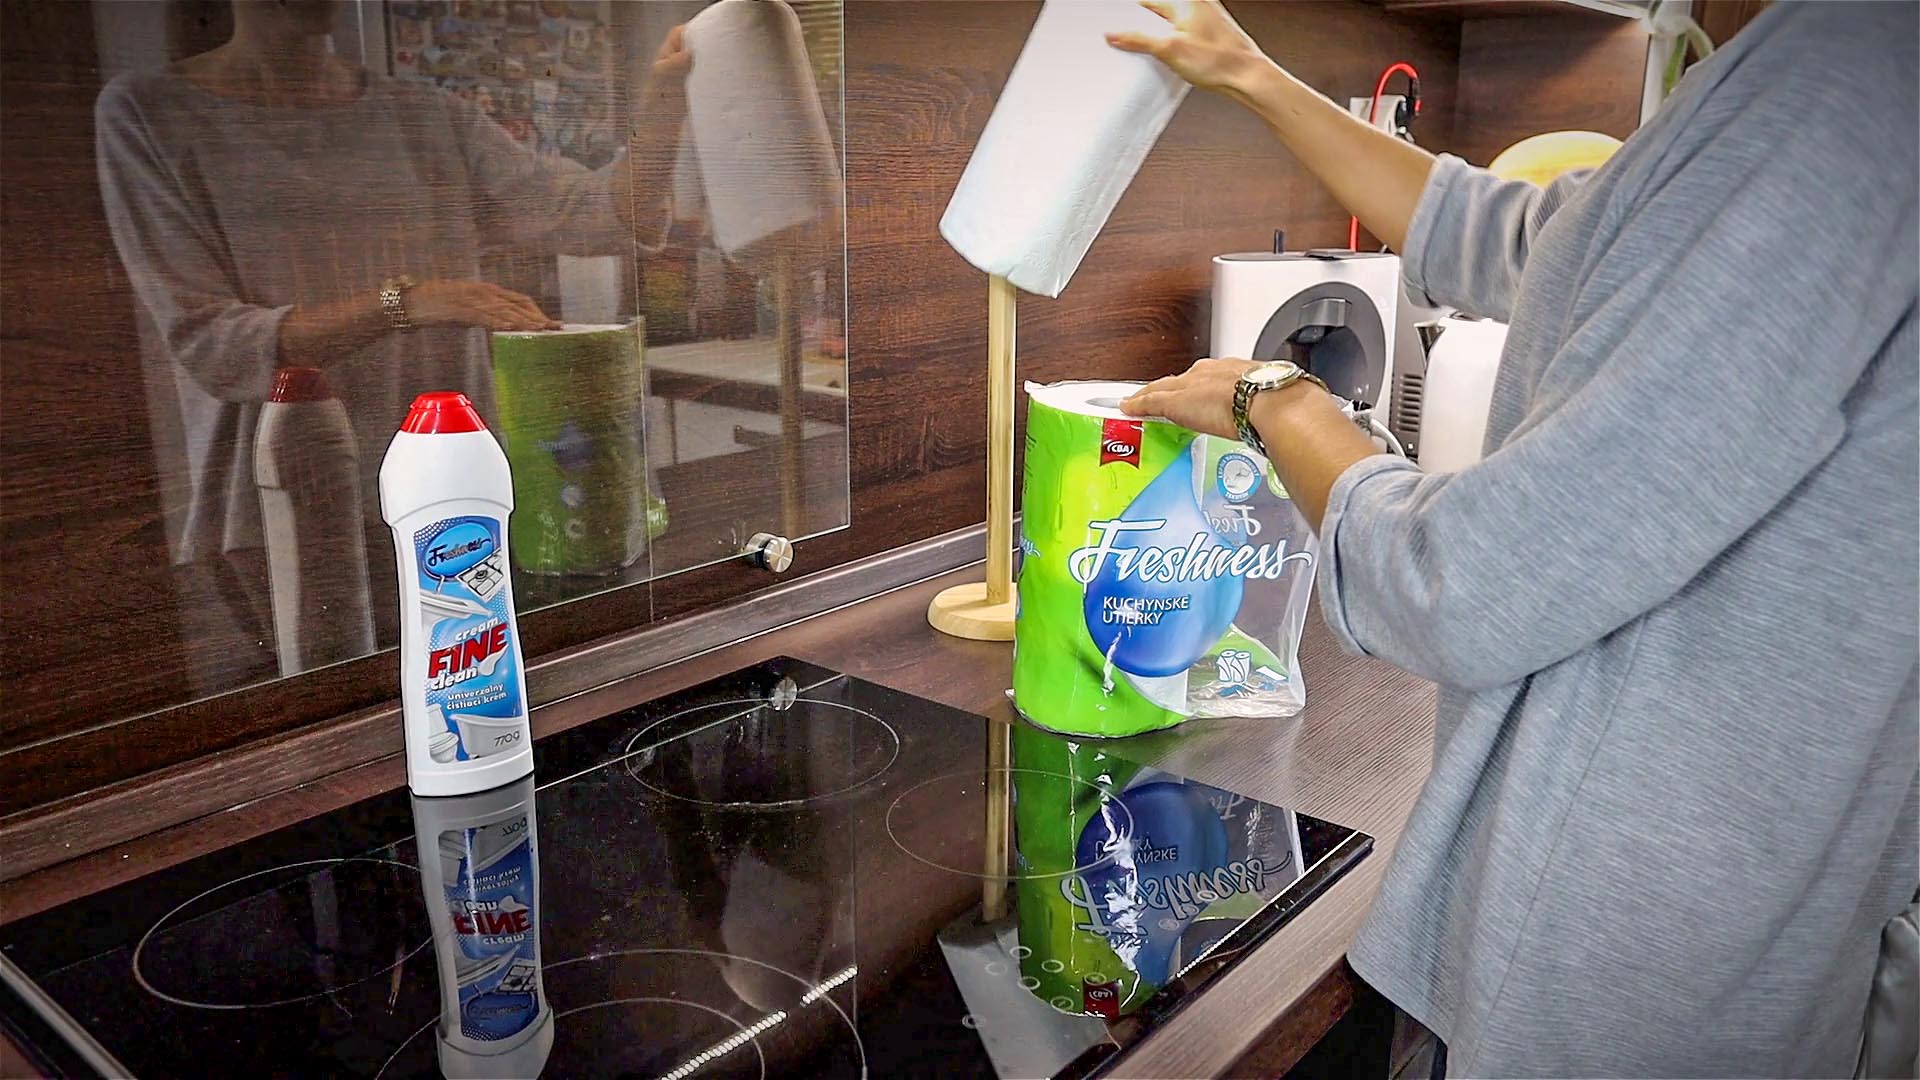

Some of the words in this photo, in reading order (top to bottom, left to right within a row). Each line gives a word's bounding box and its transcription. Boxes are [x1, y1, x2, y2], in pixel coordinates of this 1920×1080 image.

[1110, 444, 1130, 453] CBA
[1069, 519, 1312, 583] Freshness
[1103, 596, 1190, 611] KUCHYNSKE
[455, 617, 499, 641] cream
[1102, 610, 1163, 625] UTIERKY
[428, 623, 509, 679] FINE
[431, 666, 478, 691] clean
